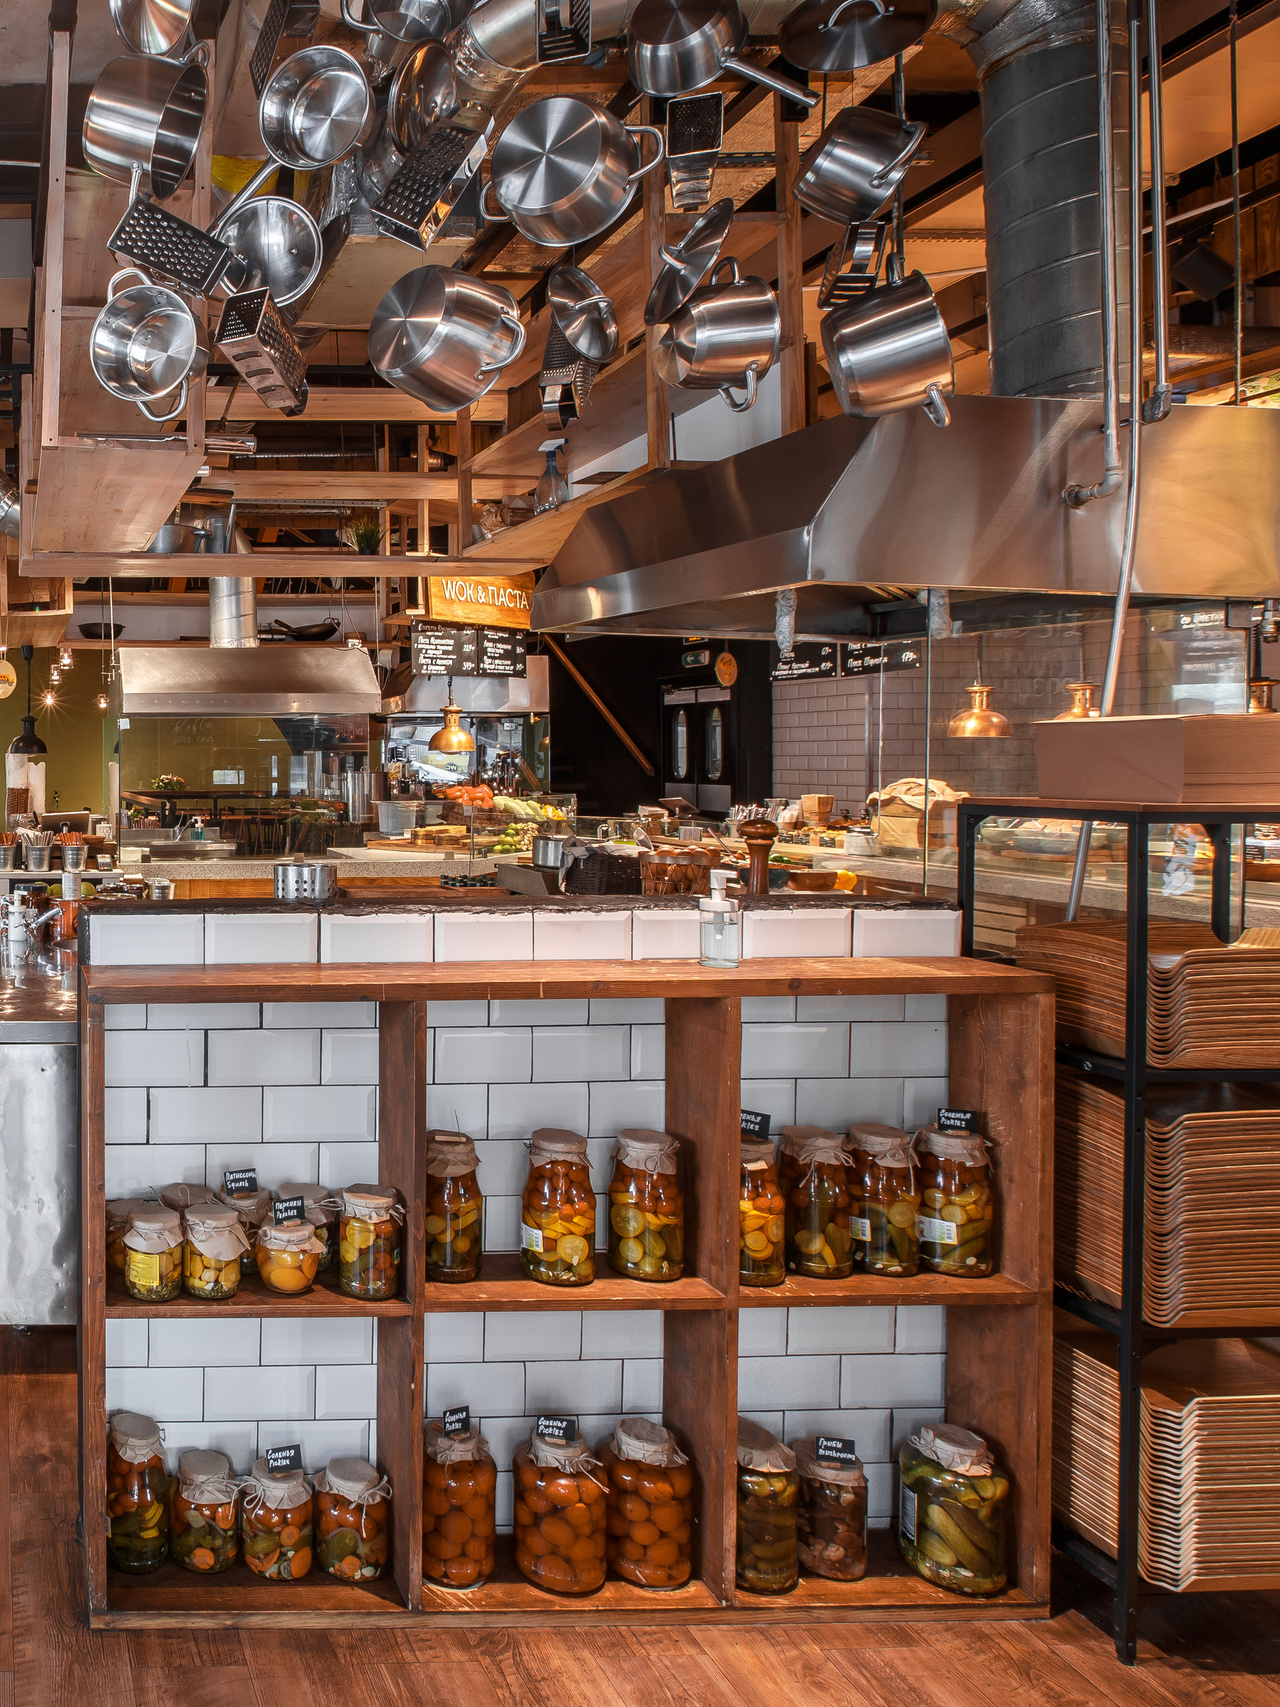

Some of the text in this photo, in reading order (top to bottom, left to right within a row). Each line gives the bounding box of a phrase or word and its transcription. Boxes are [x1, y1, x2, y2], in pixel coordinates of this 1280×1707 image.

[442, 579, 530, 610] WOK & ПАСТА
[538, 1425, 564, 1437] Pickles
